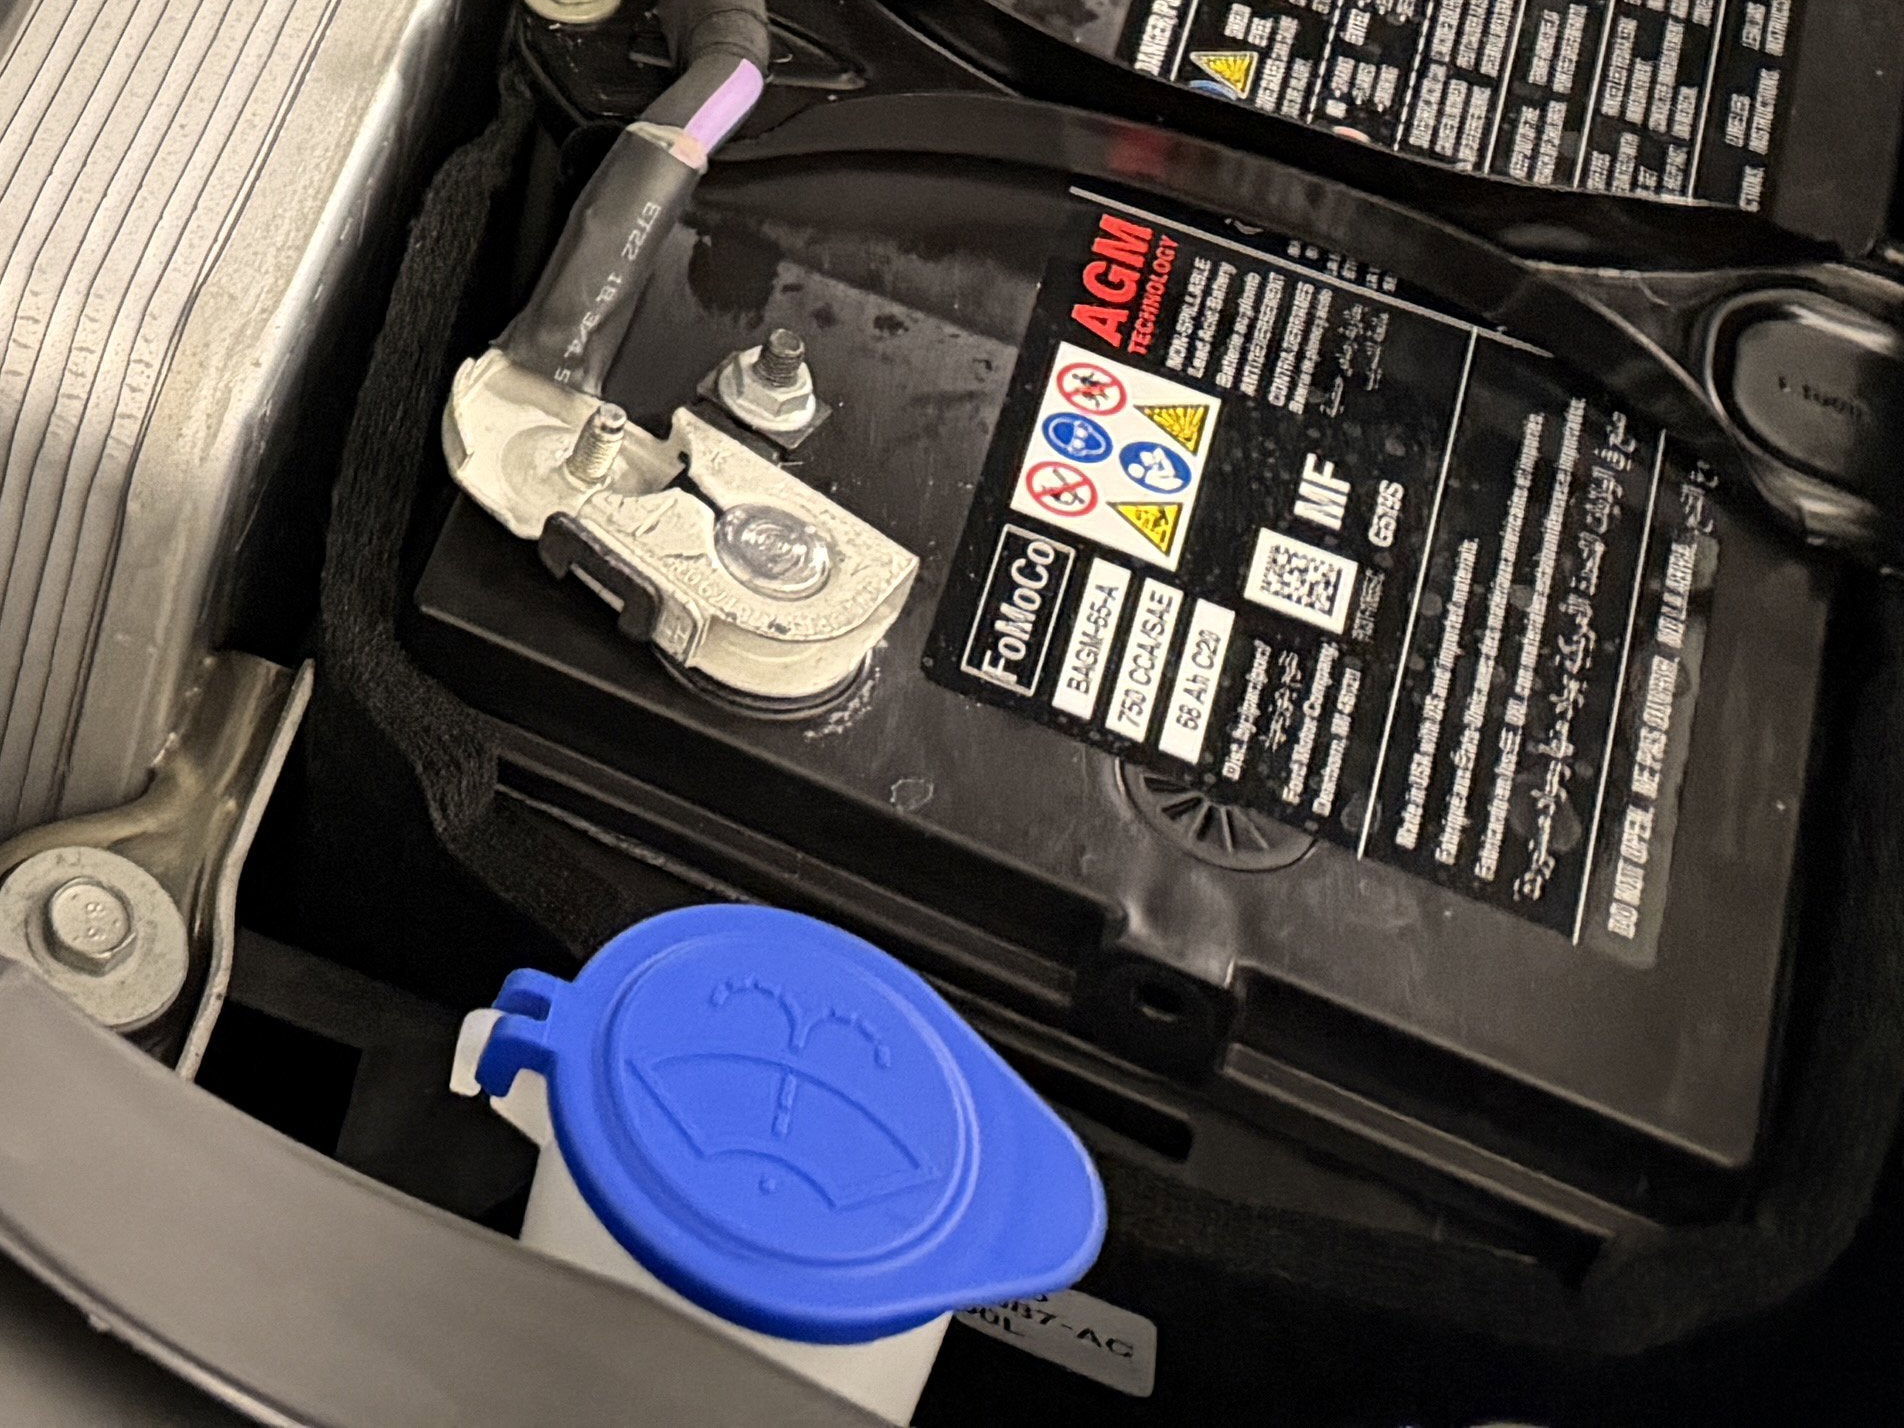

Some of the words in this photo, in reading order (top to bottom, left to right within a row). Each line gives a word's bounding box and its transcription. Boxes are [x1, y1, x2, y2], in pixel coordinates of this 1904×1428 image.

[1065, 212, 1155, 349] AGM
[1126, 233, 1180, 358] TECHNOLOGY
[1292, 451, 1355, 530] MF
[980, 534, 1057, 686] FoMoCo
[1065, 579, 1118, 696] BAGM-65-A
[1126, 588, 1174, 686] CCA/SAE
[1114, 680, 1149, 729] 750
[1175, 701, 1203, 732] 68
[1182, 670, 1210, 704] Ah
